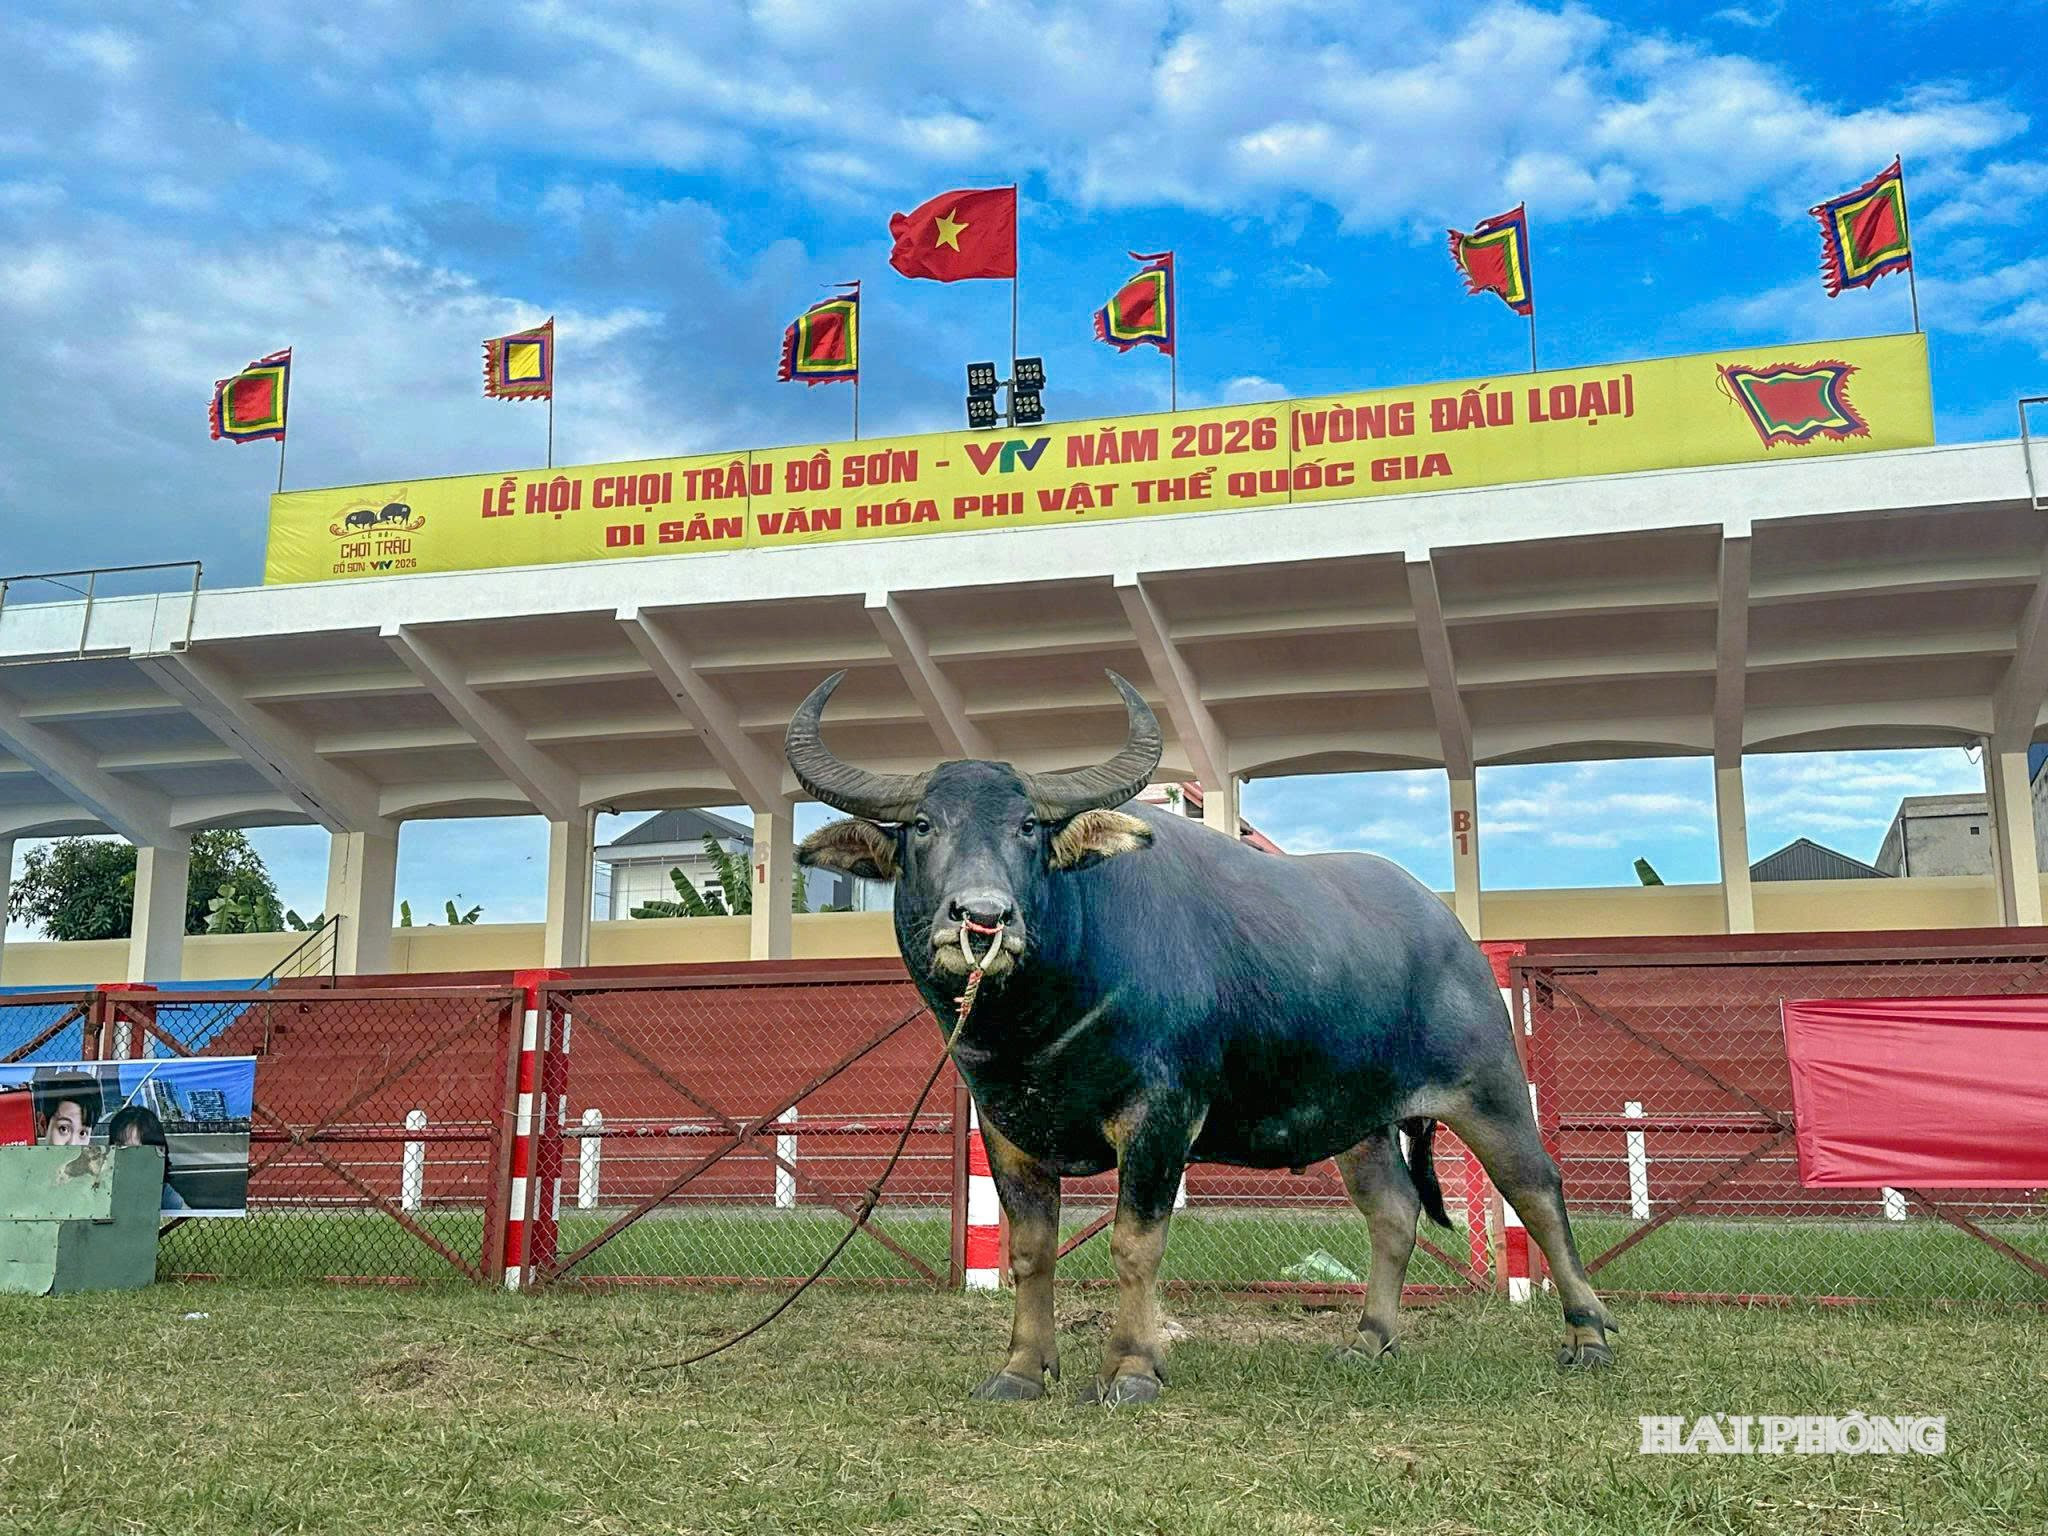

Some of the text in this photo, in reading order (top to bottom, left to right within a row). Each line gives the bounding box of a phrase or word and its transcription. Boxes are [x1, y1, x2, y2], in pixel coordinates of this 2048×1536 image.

[482, 475, 517, 517] LỄ
[525, 474, 581, 520] HỘI
[593, 472, 672, 513] CHỌI
[683, 459, 773, 501] TRÂU
[785, 449, 831, 493] ĐỒ
[842, 447, 919, 489] SƠN
[963, 437, 1052, 475] VTV
[1065, 426, 1159, 469] NĂM
[1171, 417, 1277, 459] 2026
[1429, 383, 1514, 434] ĐẤU
[606, 453, 1452, 548] DI SẢN VĂN HÓA PHI VẬT THỂ QUỐC GIA
[370, 560, 393, 570] VTV
[395, 558, 416, 569] 2026
